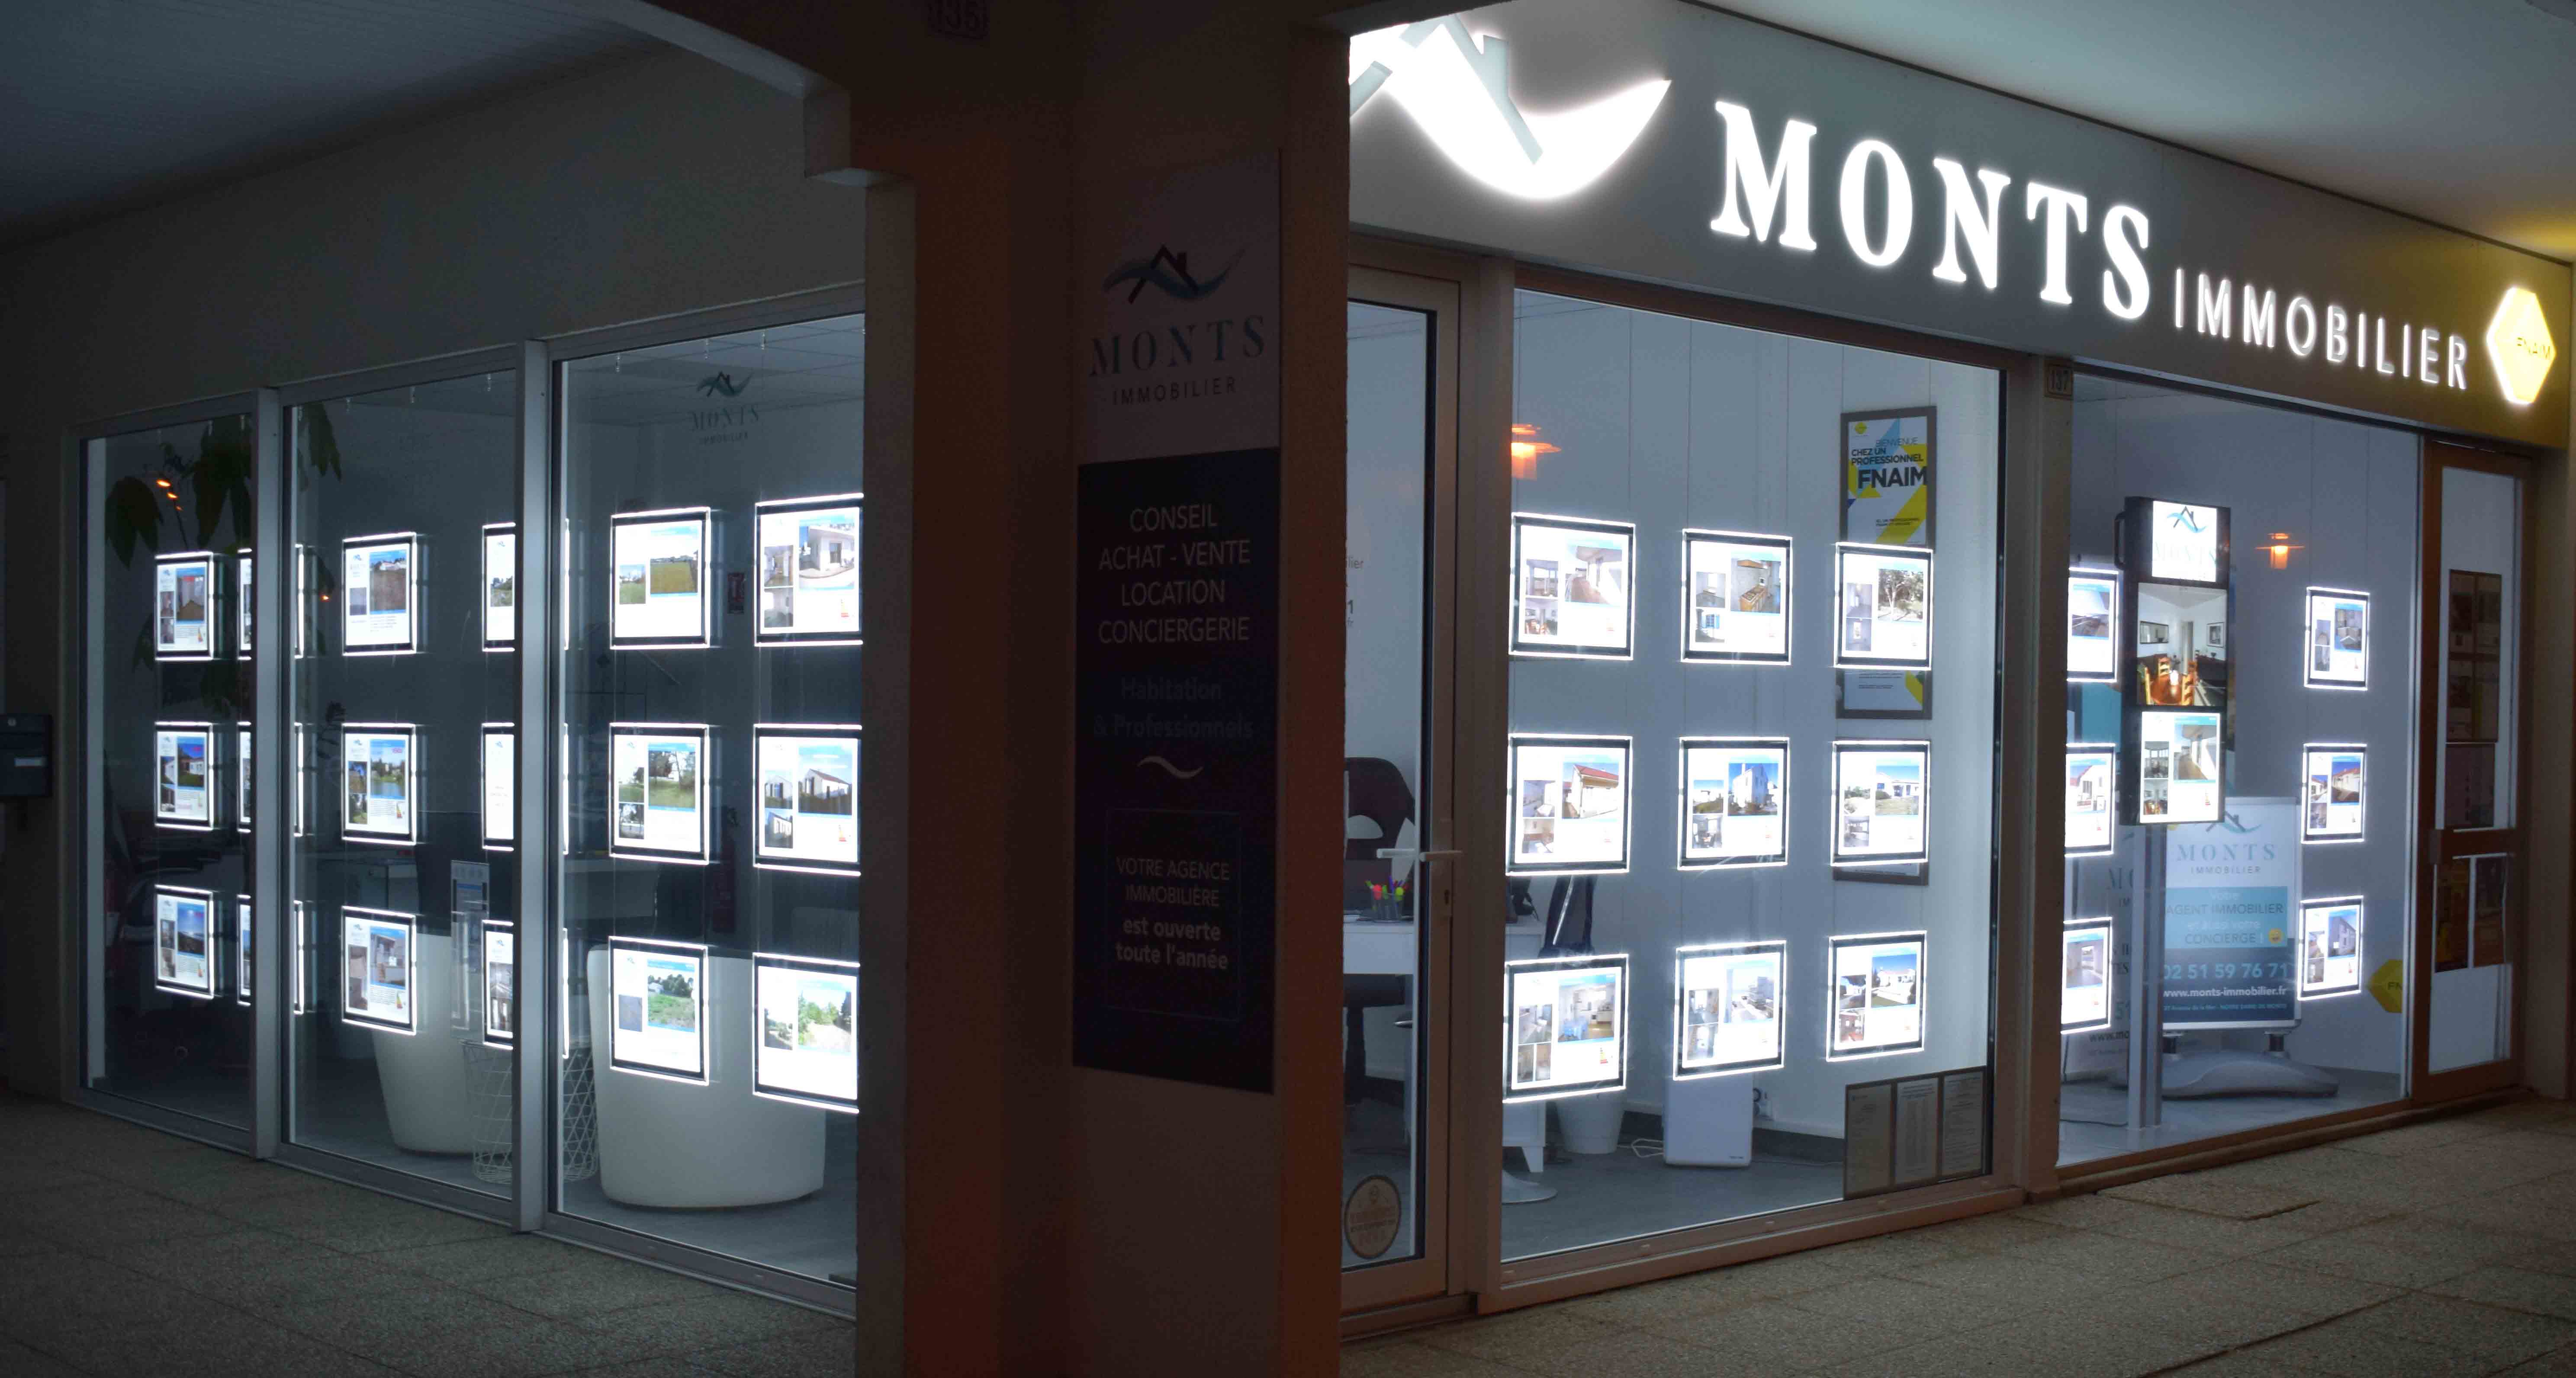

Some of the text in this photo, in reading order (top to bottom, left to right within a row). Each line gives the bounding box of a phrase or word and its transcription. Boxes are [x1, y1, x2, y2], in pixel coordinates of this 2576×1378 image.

[1711, 100, 2467, 390] MONTS IMMOBILIER
[1089, 315, 1264, 377] MONTS
[1113, 376, 1236, 405] IMMOBILIER
[1851, 453, 1924, 465] PROFESSIONNEL
[1852, 448, 1873, 456] CHEZ
[1859, 466, 1927, 489] FNAIM
[1129, 503, 1218, 533] CONSEIL
[1098, 544, 1165, 571] ACHAT
[1181, 539, 1250, 567] VENTE
[1121, 579, 1225, 607] LOCATION
[1098, 616, 1250, 645] CONCIERGERIE
[1121, 676, 1222, 700] Habitation
[1114, 713, 1254, 737] Professionnels
[2177, 843, 2276, 861] MONTS
[1116, 857, 1230, 881] VOTRE AGENCE
[2190, 865, 2261, 874] IMMOBILIER
[1125, 884, 1219, 908] IMMOBILIÈRE
[2165, 903, 2283, 915] AGENT IMMOBILIER
[1123, 916, 1221, 942] est ouverte
[2185, 933, 2256, 944] CONCIERGE
[1115, 941, 1229, 970] toute l'année
[2187, 964, 2208, 980] 51
[2215, 962, 2236, 979] 59
[2241, 962, 2263, 978] 76
[2267, 962, 2288, 978] 71
[2164, 985, 2288, 997] www.monts-immobilier.fr
